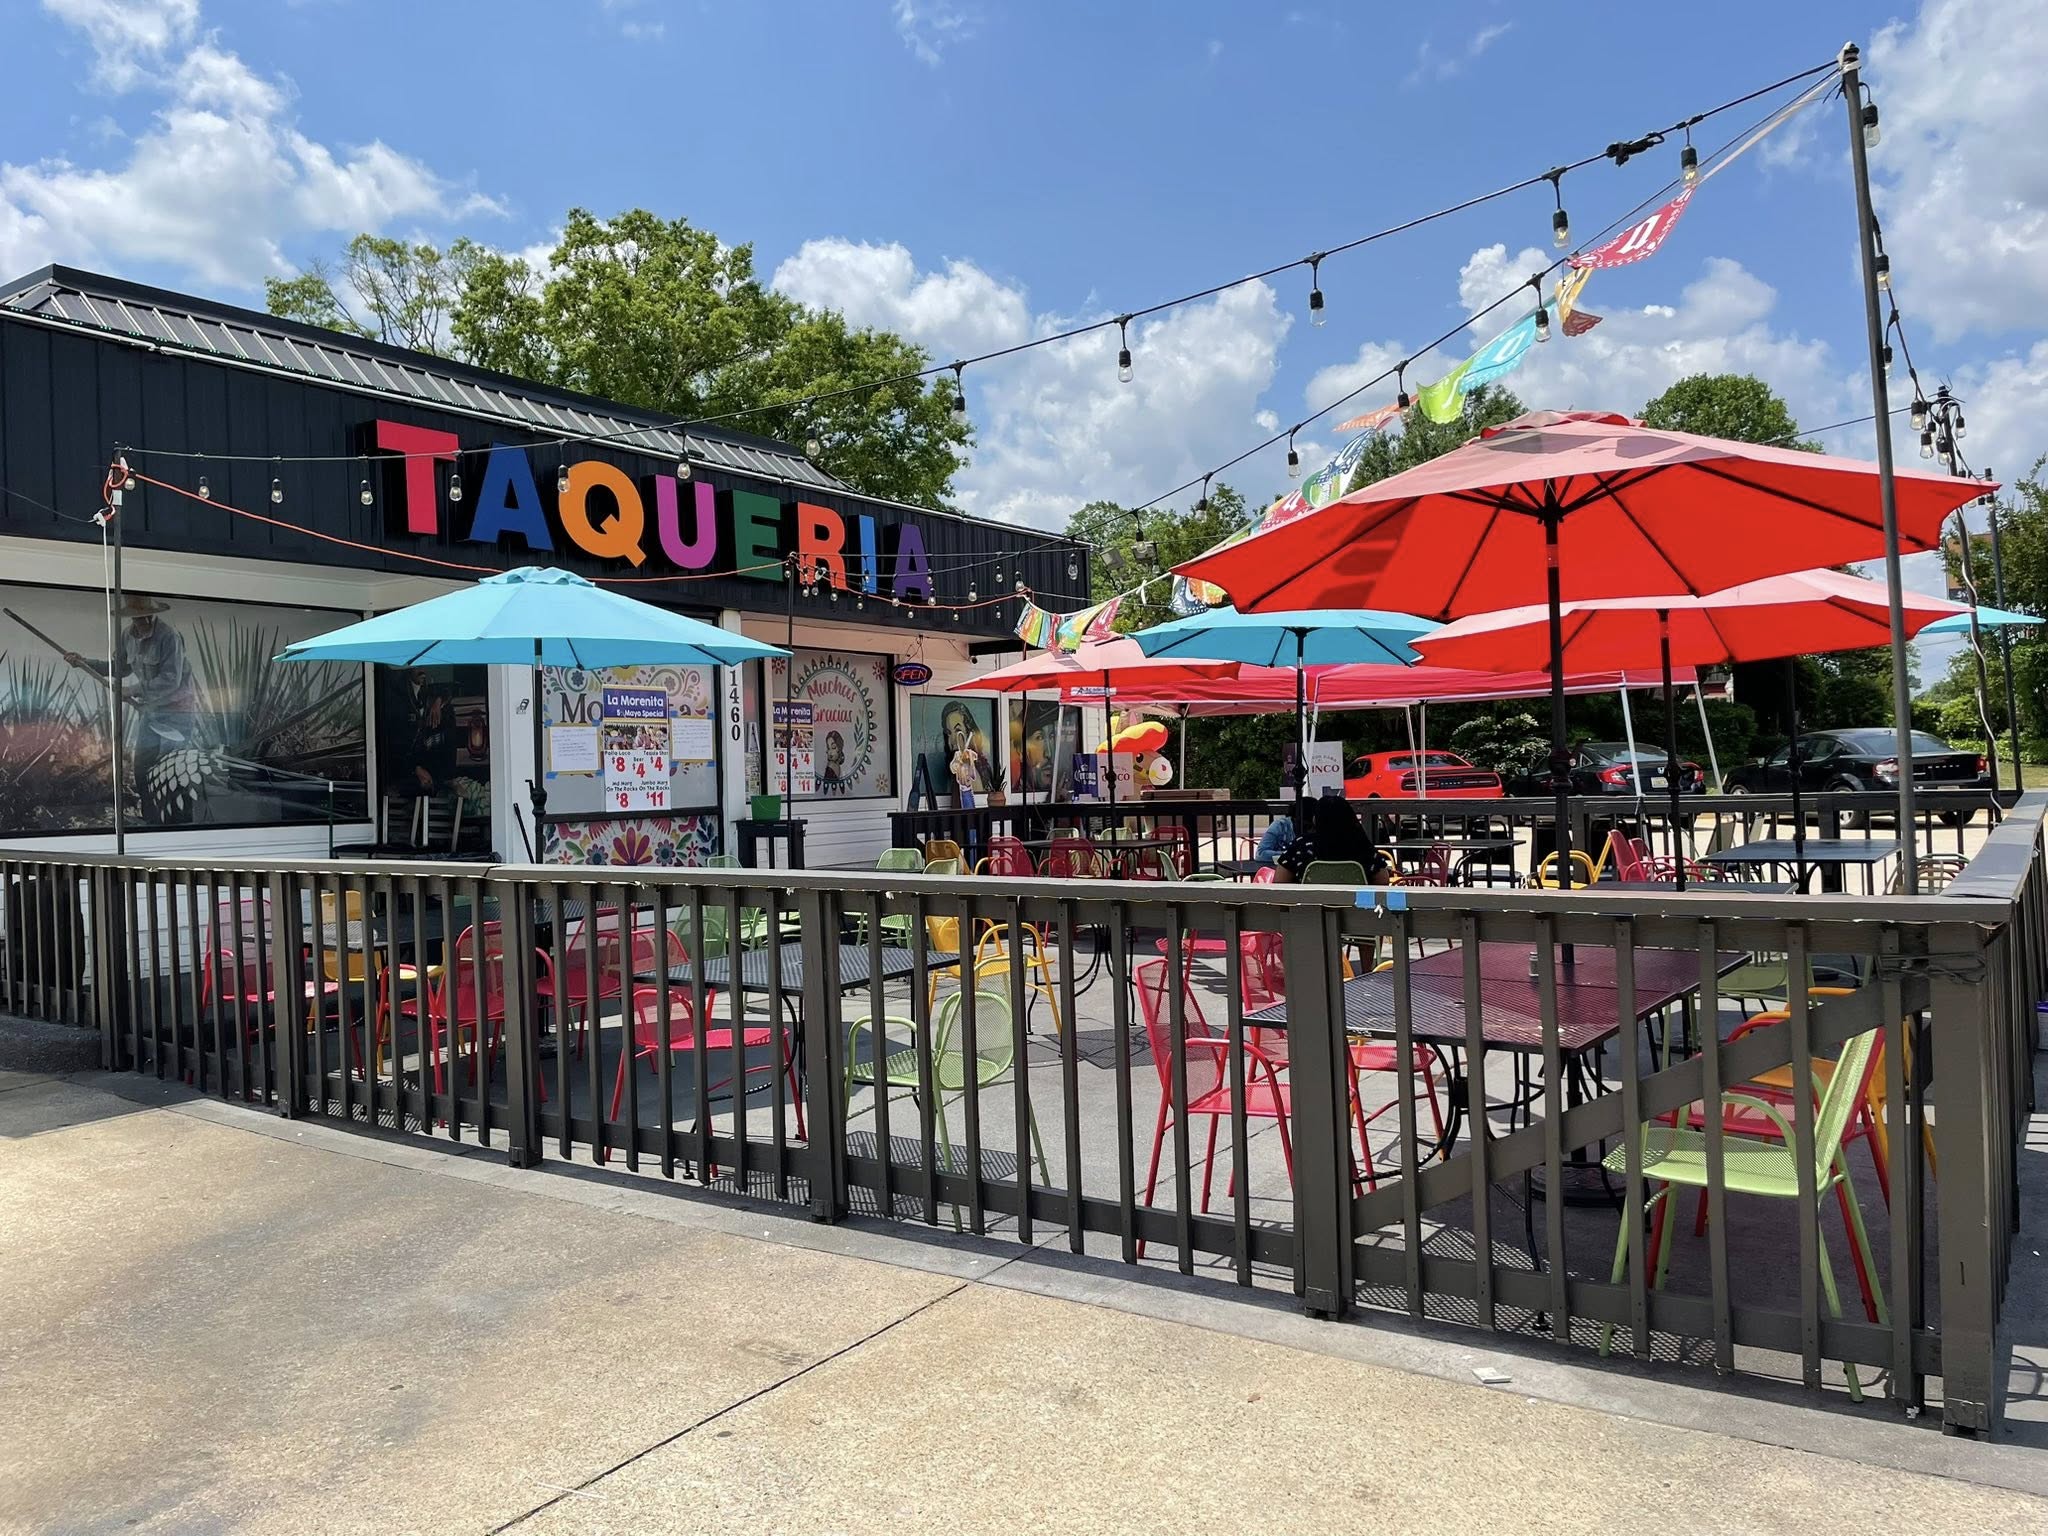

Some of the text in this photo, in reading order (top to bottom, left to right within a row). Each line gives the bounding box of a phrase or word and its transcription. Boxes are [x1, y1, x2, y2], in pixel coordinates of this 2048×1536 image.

[376, 419, 931, 600] TAQUERIA
[894, 668, 927, 680] OPEN
[807, 676, 857, 703] Muchas
[607, 695, 664, 707] La Morenita
[729, 669, 741, 741] 1460
[624, 709, 641, 718] Mayo
[642, 710, 664, 718] Special
[781, 706, 811, 716] Mrenita
[813, 704, 853, 723] Gracias
[612, 756, 625, 772] $8
[632, 763, 645, 778] $4
[650, 756, 663, 771] $4
[1311, 765, 1340, 773] INCO
[616, 792, 629, 808] $8
[646, 791, 664, 807] $11
